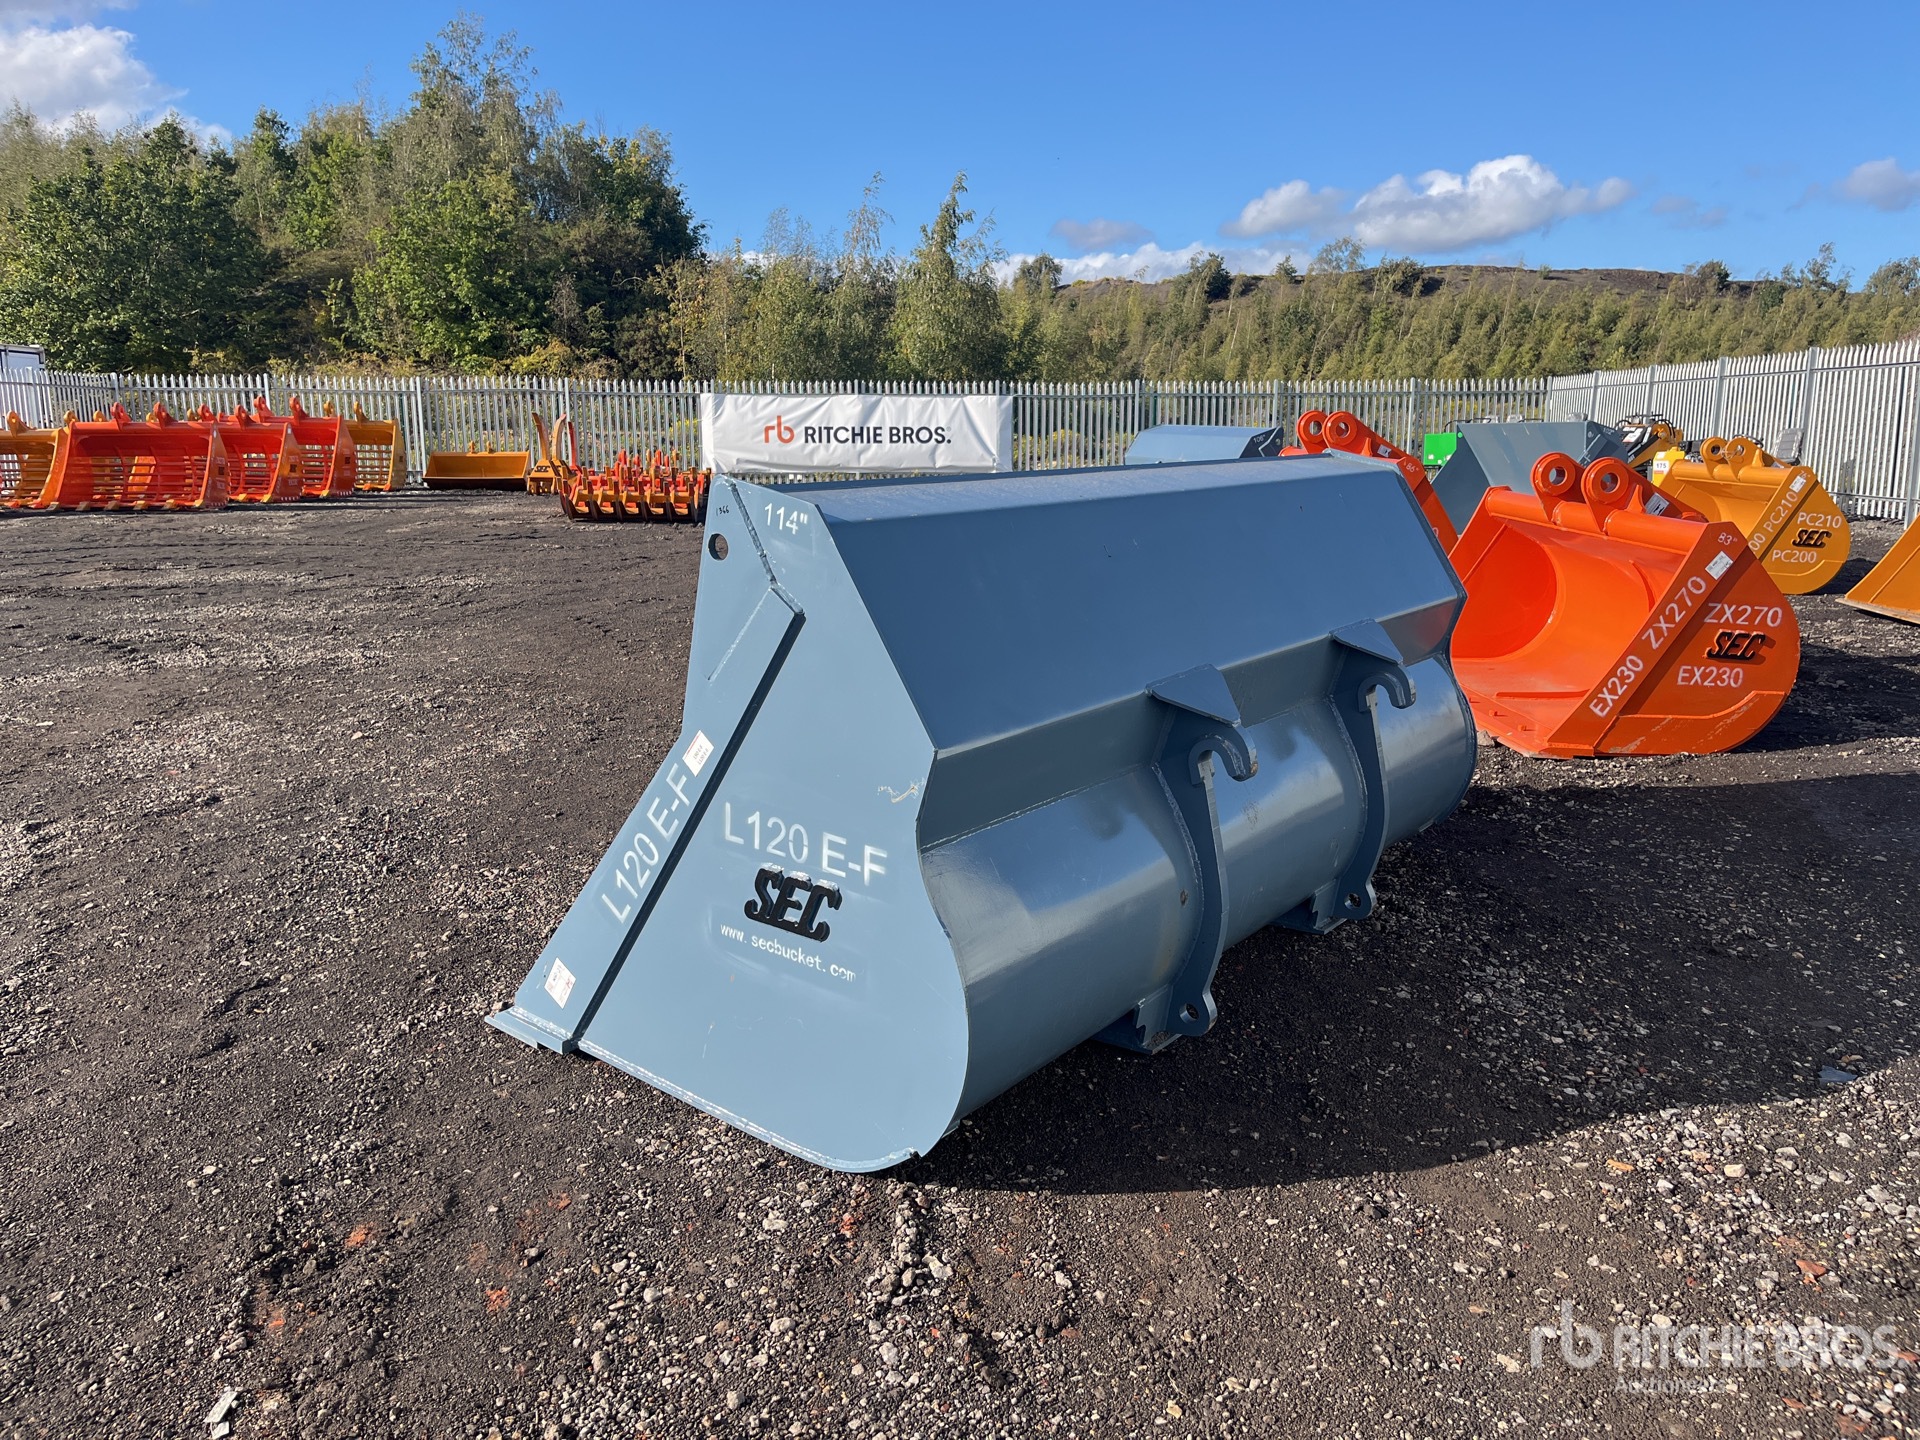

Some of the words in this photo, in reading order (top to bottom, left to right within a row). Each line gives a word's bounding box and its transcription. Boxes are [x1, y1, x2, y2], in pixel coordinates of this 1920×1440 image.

[764, 415, 795, 444] rb
[804, 426, 882, 444] RITCHIE
[888, 426, 951, 444] BROS.
[764, 502, 808, 535] 114"
[1763, 491, 1798, 532] PC210
[1797, 512, 1842, 528] PC210
[1791, 528, 1832, 549] SEC
[1772, 549, 1817, 564] PC200
[1703, 603, 1783, 628] ZX270
[1589, 655, 1645, 718] EX230
[1642, 575, 1707, 650] ZX270
[1703, 629, 1766, 661] SEC
[1676, 665, 1744, 688] EX230
[602, 832, 659, 924] L120
[646, 763, 691, 842] E-F
[724, 801, 809, 864] L120
[822, 832, 888, 886] E-F
[744, 862, 842, 943] SEC
